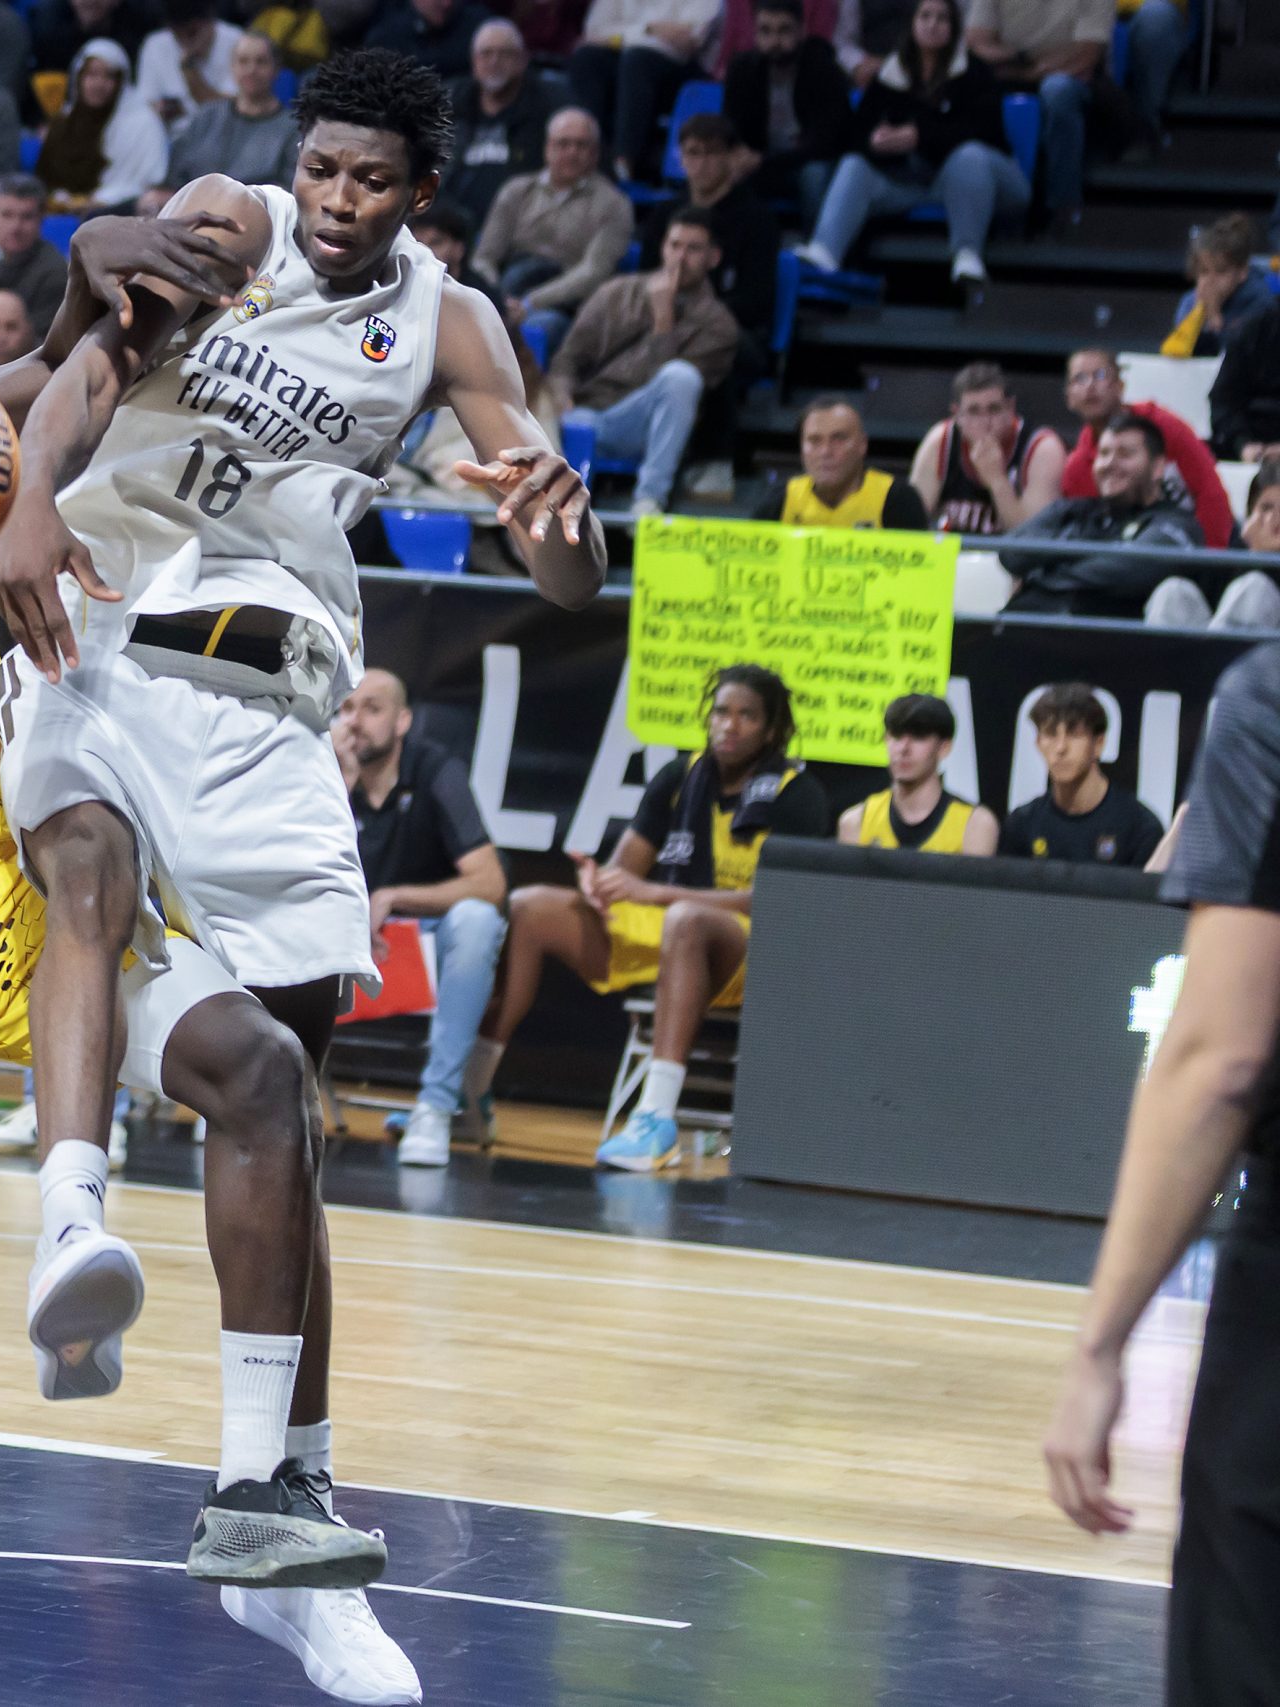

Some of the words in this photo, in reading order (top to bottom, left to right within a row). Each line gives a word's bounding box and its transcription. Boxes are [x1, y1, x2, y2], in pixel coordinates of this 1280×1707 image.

[369, 316, 394, 342] LIGA
[176, 371, 230, 413] FLY
[223, 392, 311, 462] BETTER
[184, 334, 358, 445] mirates
[174, 438, 253, 519] 18
